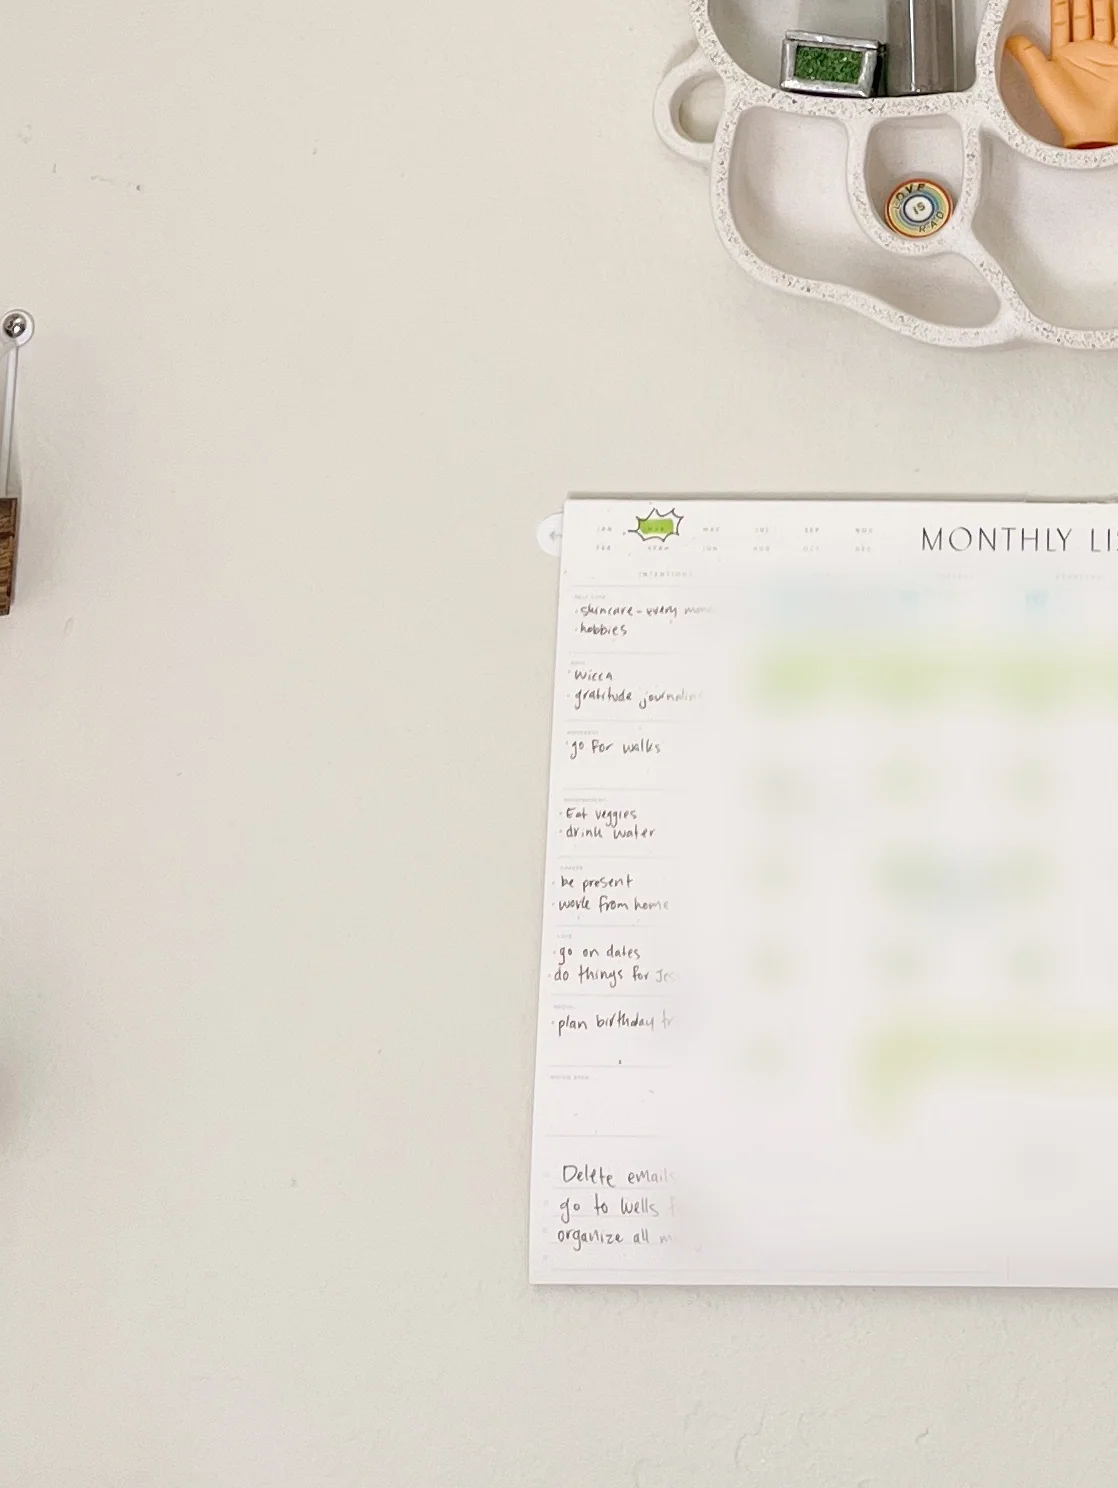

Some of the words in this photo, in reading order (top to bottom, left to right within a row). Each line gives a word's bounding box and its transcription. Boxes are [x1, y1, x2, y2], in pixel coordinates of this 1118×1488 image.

[892, 183, 926, 210] LOVE
[913, 202, 926, 215] IS
[918, 211, 944, 233] RAD
[921, 526, 1073, 552] MONTHLY
[580, 604, 634, 617] skincare
[645, 605, 678, 619] every
[579, 622, 628, 636] hobbies
[574, 686, 632, 711] gratitude
[570, 741, 585, 760] go
[622, 737, 661, 754] walks
[566, 808, 588, 820] Eat
[595, 808, 638, 828] veggies
[566, 824, 603, 838] drink
[613, 824, 656, 840] water
[560, 875, 574, 888] be
[582, 873, 634, 893] present
[558, 896, 591, 911] work
[599, 894, 629, 913] from
[634, 897, 669, 911] home
[558, 946, 573, 966] go
[582, 947, 599, 959] on
[606, 944, 641, 960] dates
[553, 966, 569, 981] do
[578, 965, 624, 988] things
[632, 965, 649, 981] for
[558, 1014, 587, 1037] plan
[596, 1010, 654, 1032] birthday
[562, 1164, 616, 1188] Delete
[559, 1197, 581, 1224] go
[594, 1193, 608, 1217] to
[557, 1228, 624, 1252] organize
[633, 1228, 650, 1245] all
